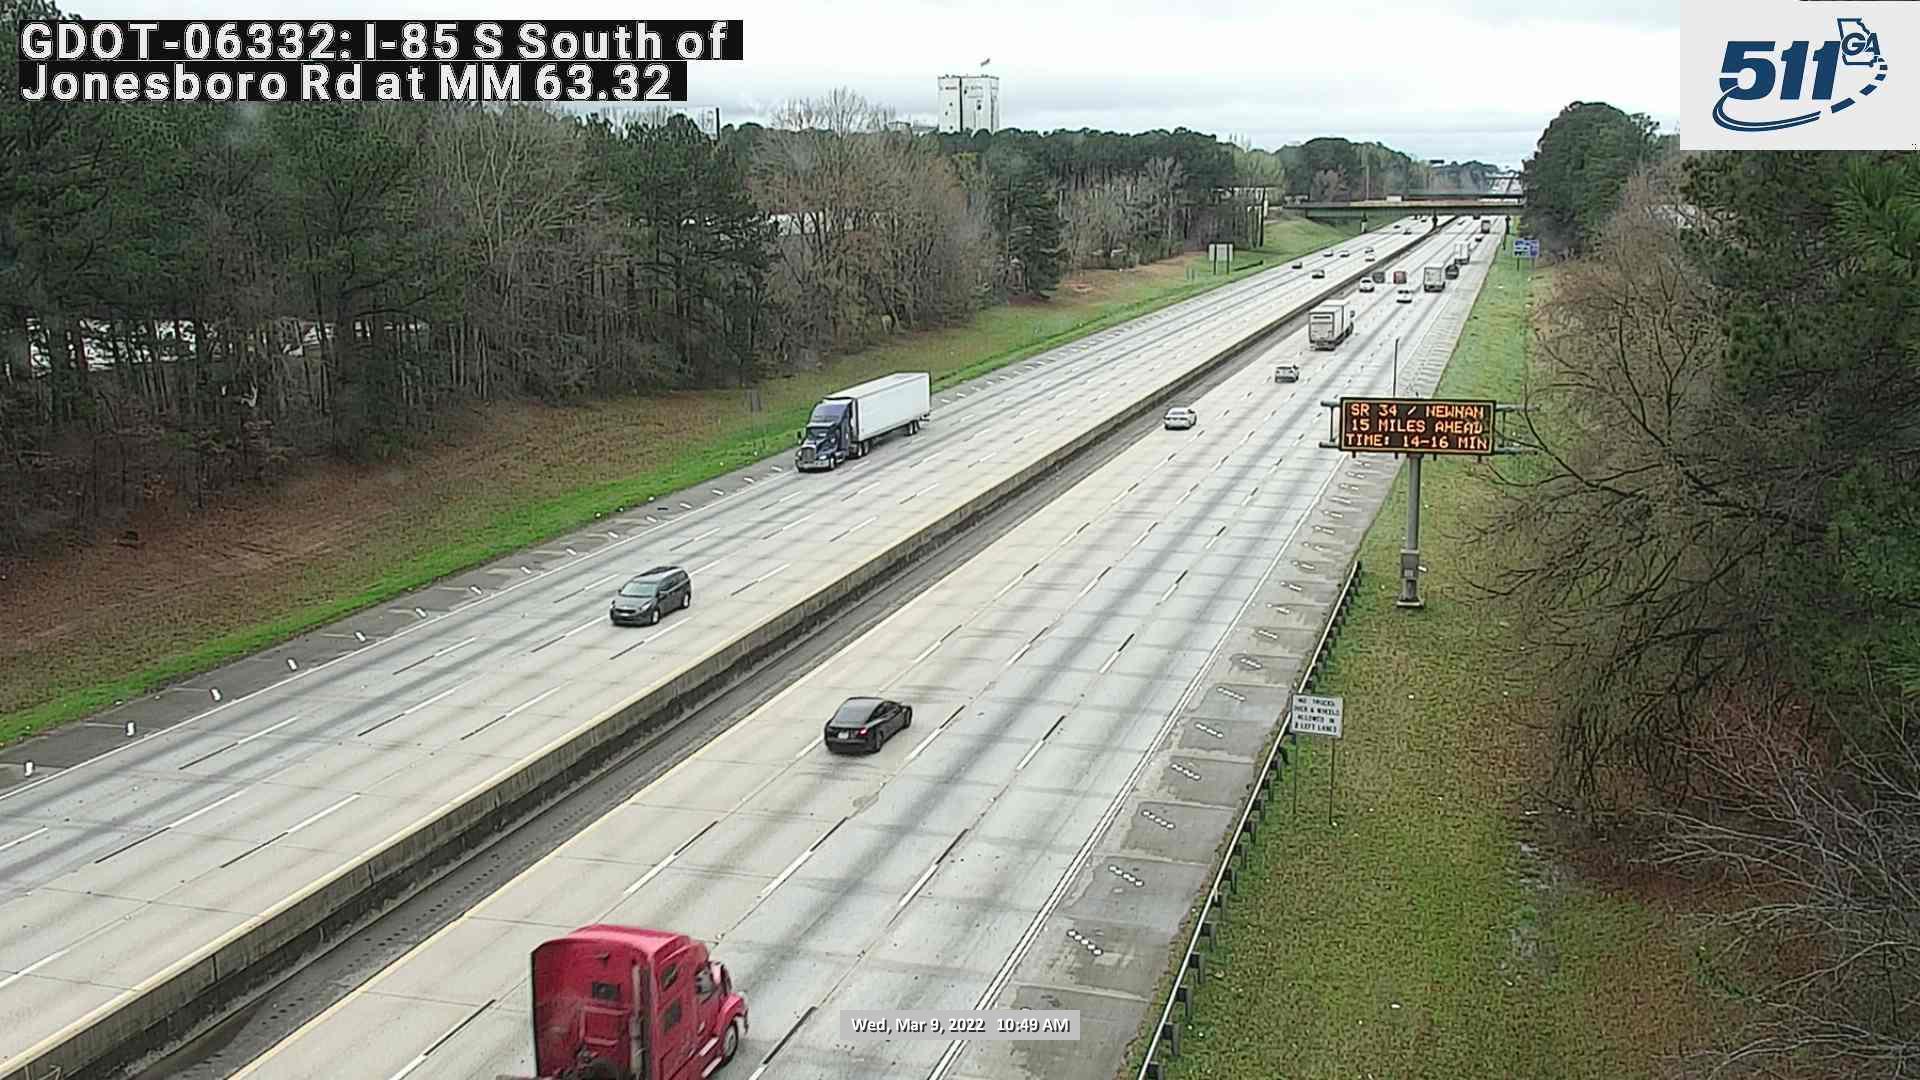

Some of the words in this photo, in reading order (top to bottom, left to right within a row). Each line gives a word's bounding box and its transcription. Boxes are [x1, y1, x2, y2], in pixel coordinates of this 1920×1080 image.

[1351, 404, 1370, 416] SR
[1378, 404, 1398, 417] 34
[1425, 405, 1485, 419] NEWNAN
[1351, 418, 1370, 431] 15
[1378, 419, 1425, 433] MILES
[1435, 420, 1483, 434] AHEAD
[1346, 433, 1389, 446] TIME:
[1403, 435, 1449, 448] 14-16
[1458, 437, 1488, 450] MIN
